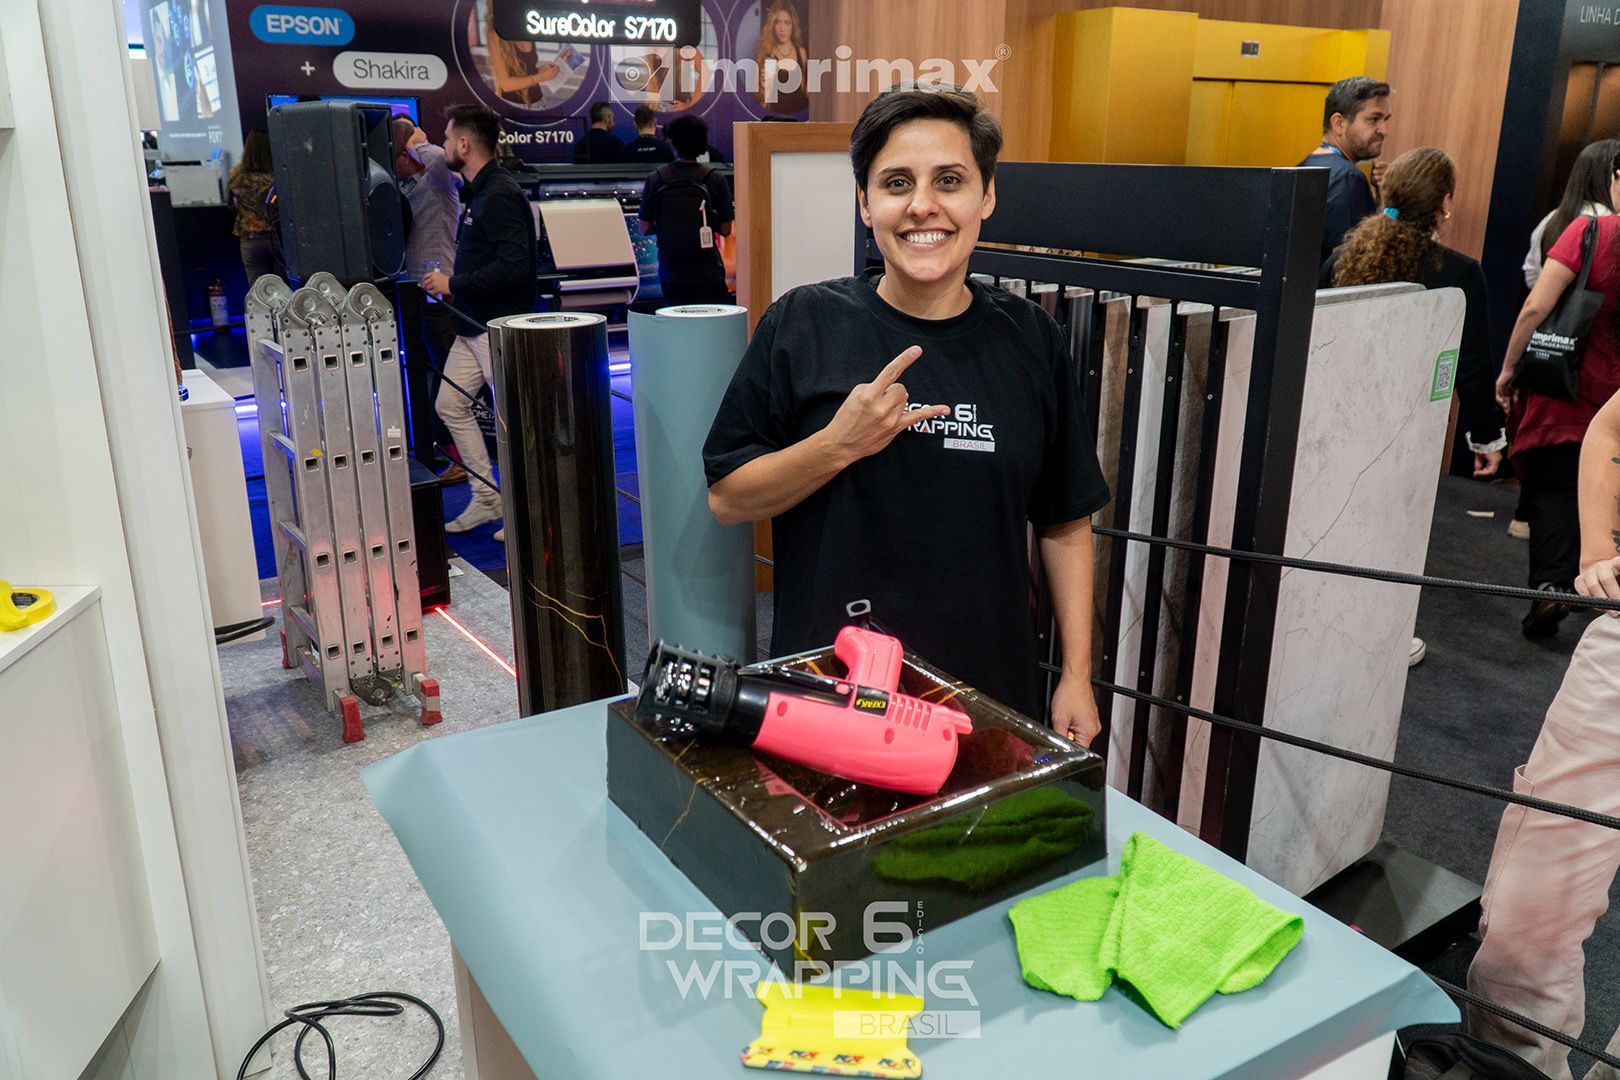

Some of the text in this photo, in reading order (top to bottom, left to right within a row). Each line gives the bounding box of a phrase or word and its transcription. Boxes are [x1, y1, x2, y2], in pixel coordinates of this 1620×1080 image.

[265, 14, 341, 36] EPSON
[526, 10, 677, 41] SureColor S7170
[1580, 6, 1611, 24] LINHA
[353, 58, 430, 81] Shakira
[498, 131, 574, 144] Color S7170
[907, 420, 995, 441] RAPPING
[952, 439, 986, 450] BRASIL
